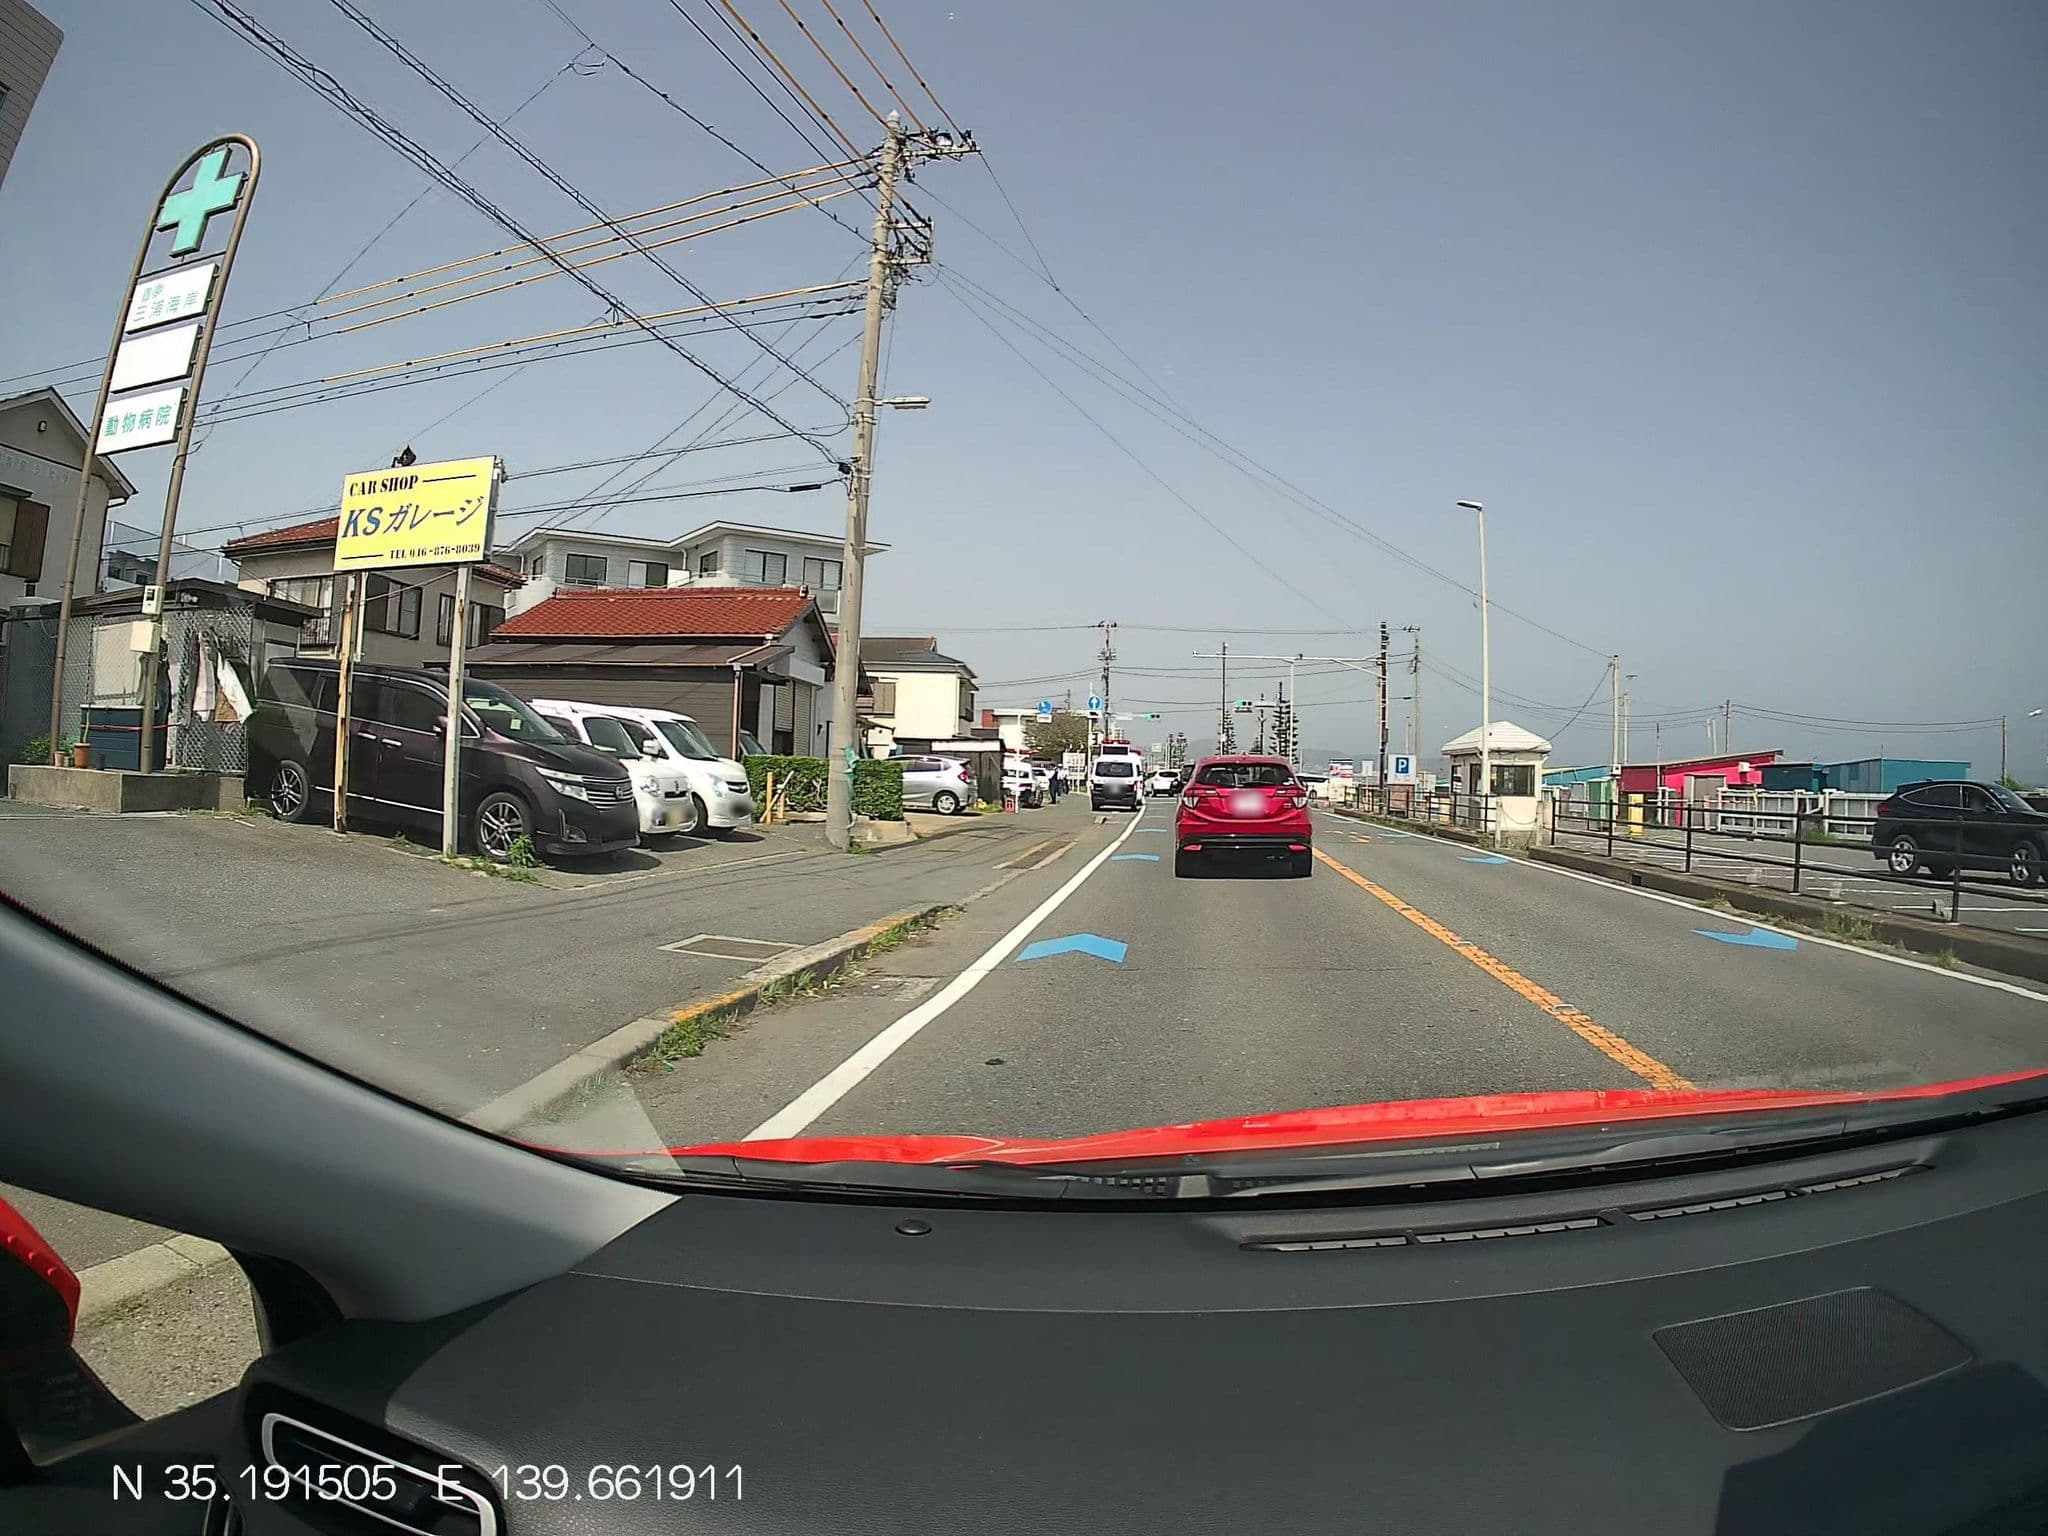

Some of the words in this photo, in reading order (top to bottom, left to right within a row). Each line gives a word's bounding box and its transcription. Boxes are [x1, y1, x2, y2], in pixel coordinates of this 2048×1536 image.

[104, 404, 172, 437] 動物病院
[349, 481, 376, 497] CAR
[380, 474, 419, 493] SHOP
[389, 549, 406, 560] TEL
[1398, 758, 1408, 772] P
